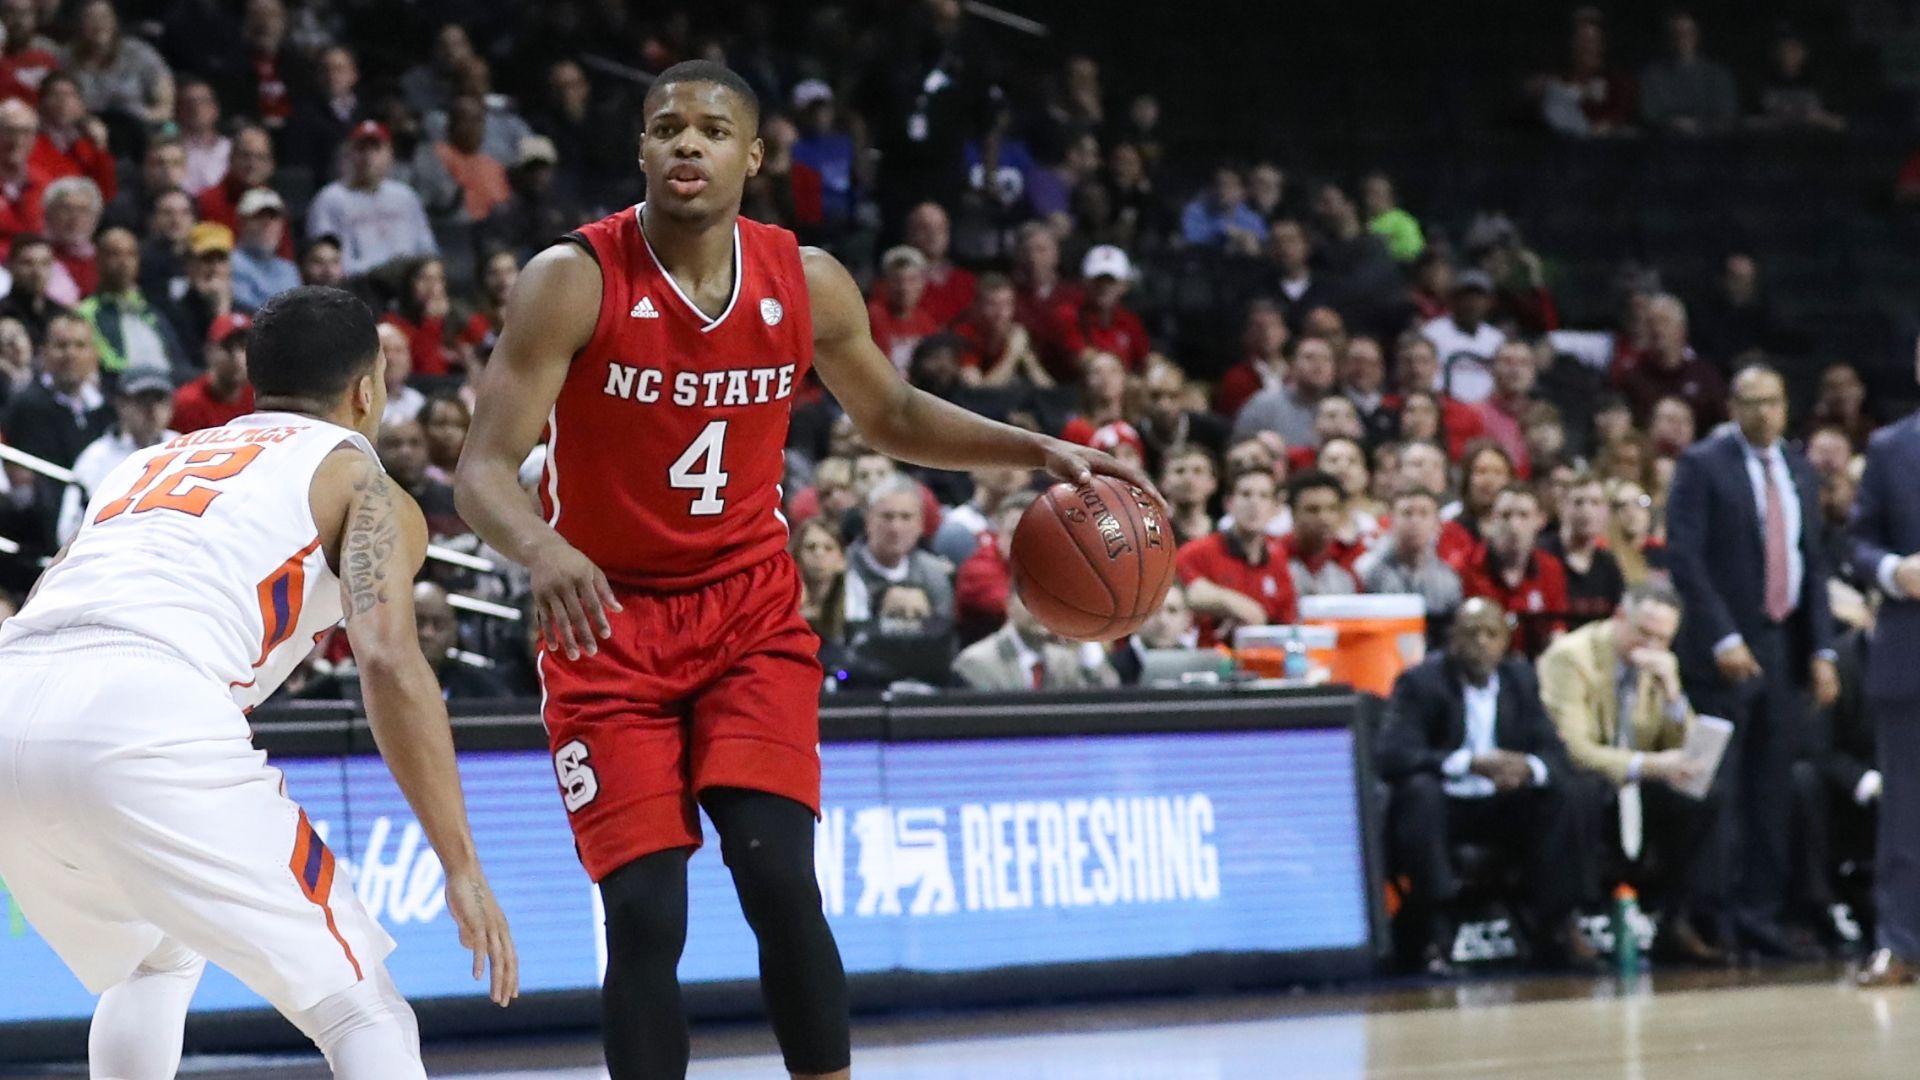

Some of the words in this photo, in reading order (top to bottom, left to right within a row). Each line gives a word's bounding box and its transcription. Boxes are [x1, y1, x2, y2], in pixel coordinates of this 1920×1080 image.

[603, 361, 664, 404] NC
[672, 362, 796, 408] STATE
[93, 443, 266, 525] 12
[668, 419, 729, 516] 4
[960, 792, 1221, 913] REFRESHING
